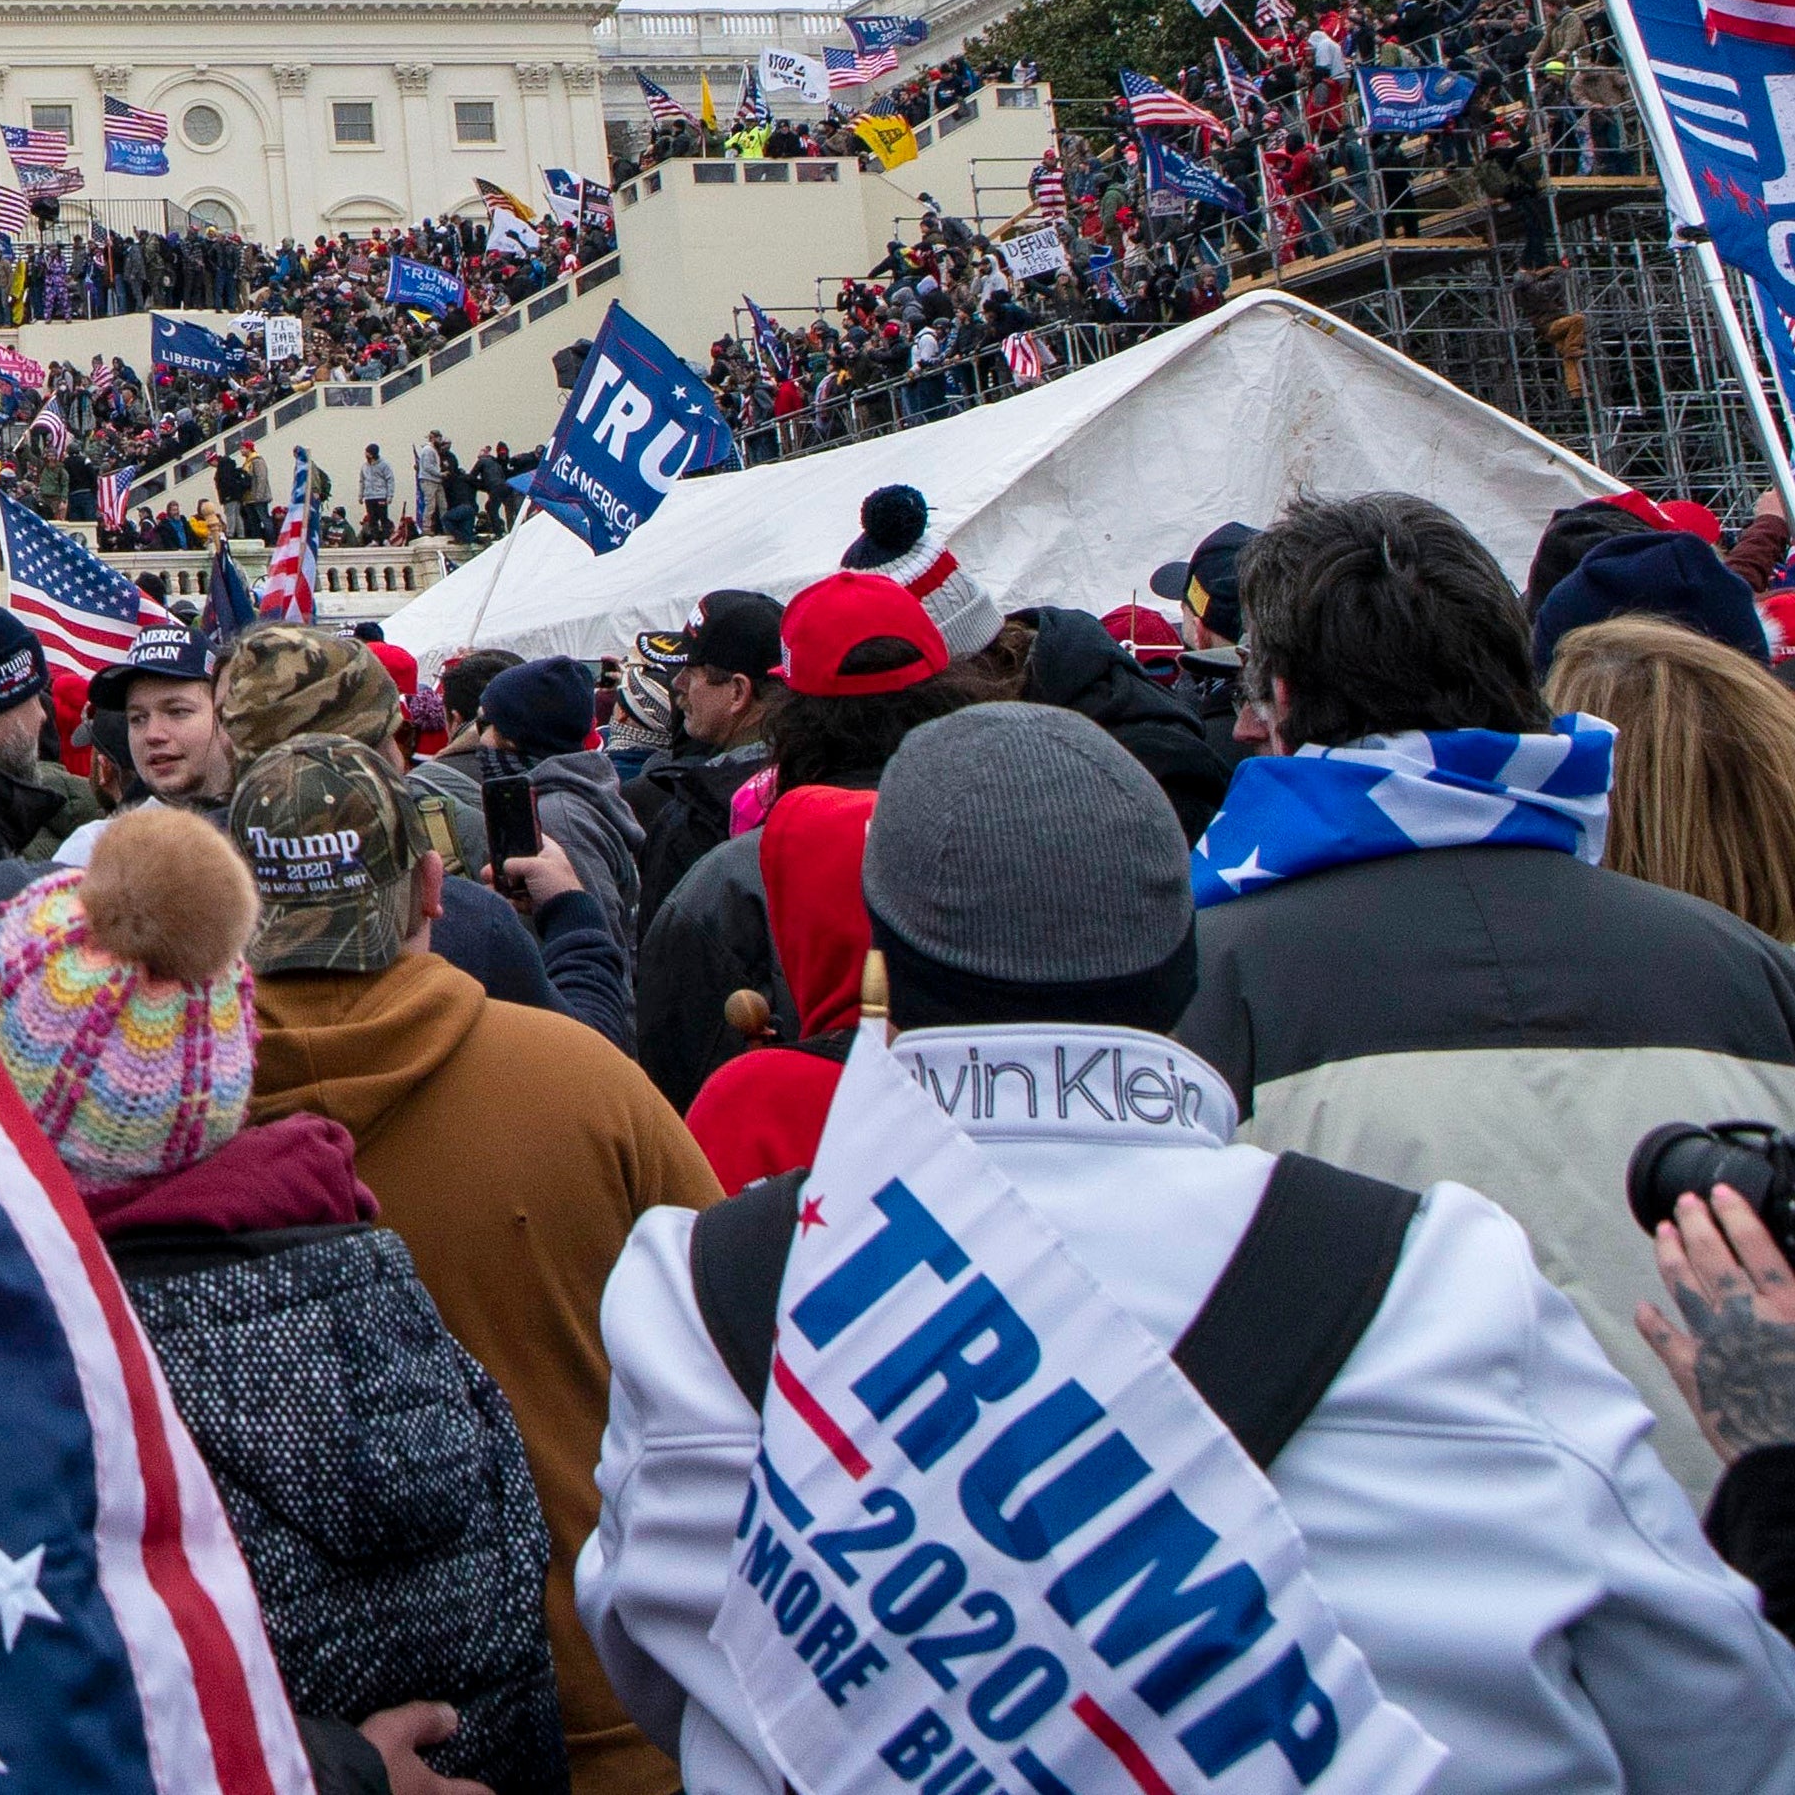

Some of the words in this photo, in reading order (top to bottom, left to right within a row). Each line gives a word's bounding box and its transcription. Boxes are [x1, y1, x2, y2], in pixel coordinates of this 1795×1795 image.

[768, 53, 797, 72] STOP
[110, 140, 161, 156] TRUMP
[1005, 229, 1060, 258] DEFUND
[1021, 248, 1052, 266] THE
[401, 265, 461, 294] TRUMP
[161, 349, 223, 373] LIBERTY
[575, 459, 638, 533] AMERICA
[141, 646, 182, 663] AGAIN
[247, 826, 361, 865] Trump
[273, 880, 307, 895] MORE
[309, 877, 339, 890] BULL
[342, 872, 368, 889] SHIT
[286, 860, 332, 880] 2020
[1054, 1045, 1203, 1129] Klein
[789, 1177, 1342, 1787] TRUMP
[744, 1537, 889, 1708] MORE
[810, 1485, 1071, 1743] 2020
